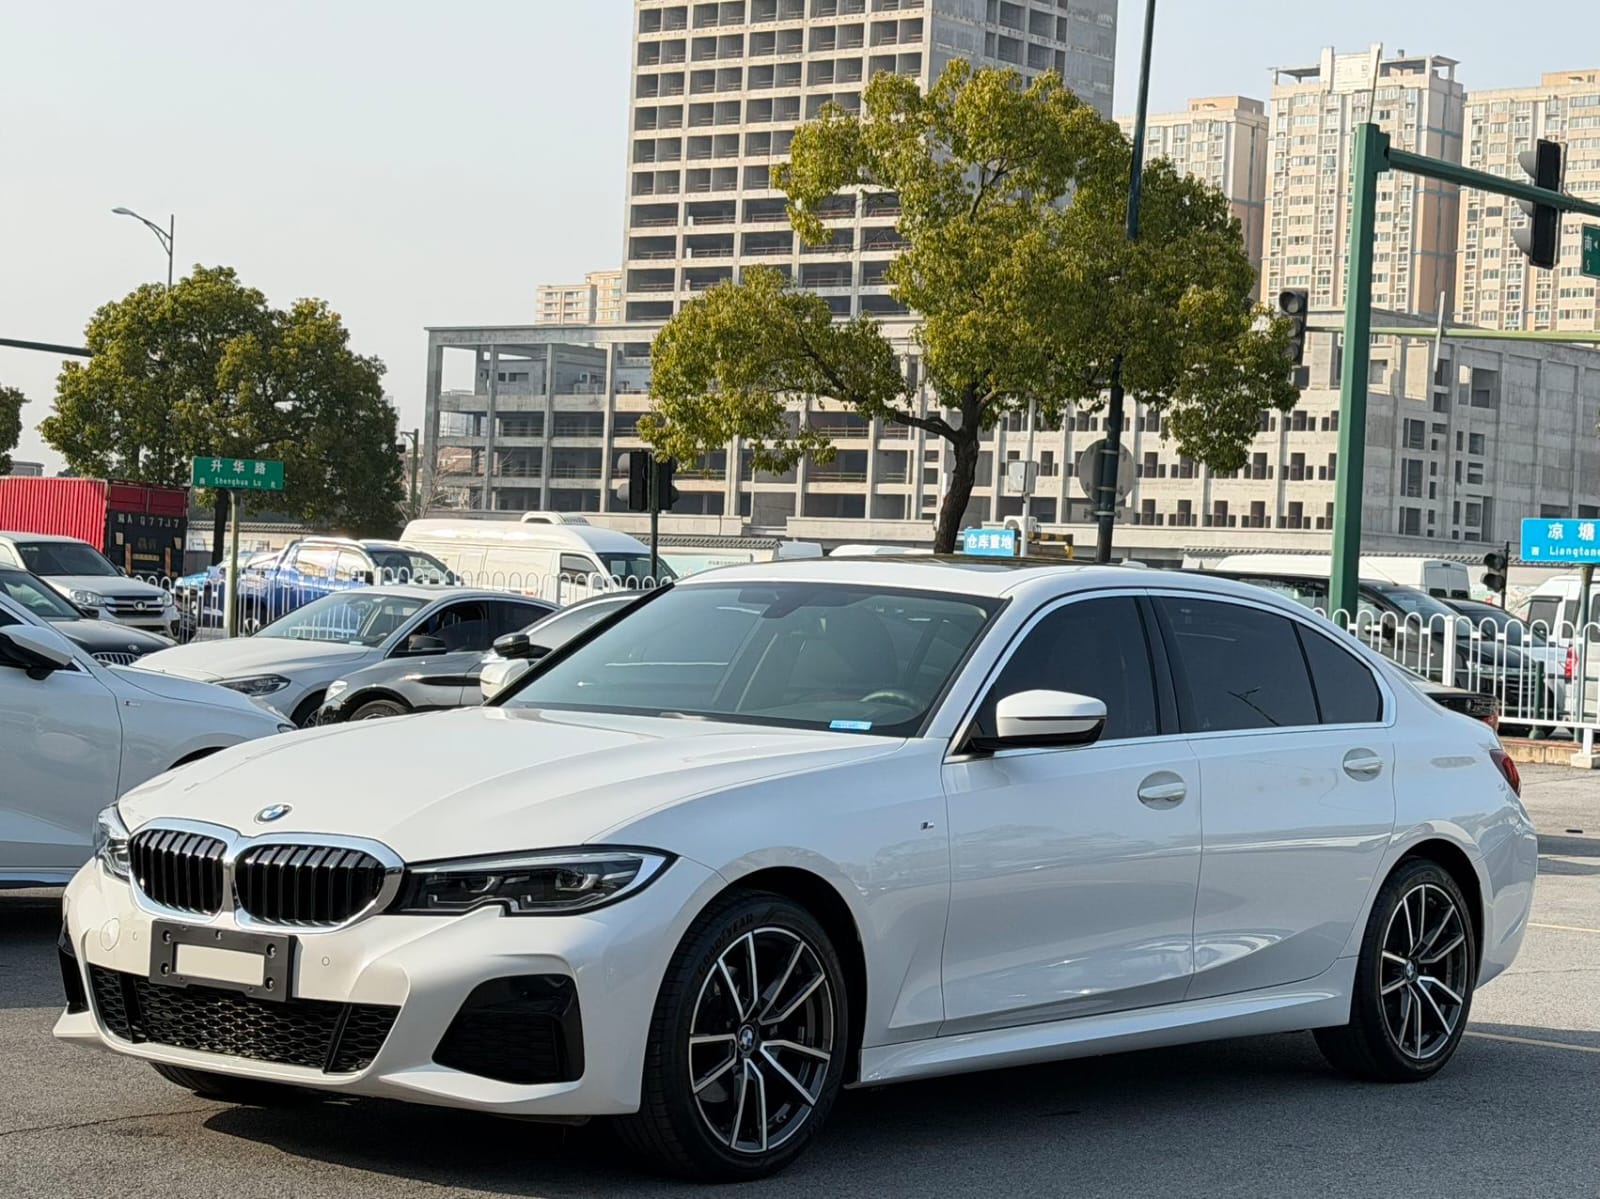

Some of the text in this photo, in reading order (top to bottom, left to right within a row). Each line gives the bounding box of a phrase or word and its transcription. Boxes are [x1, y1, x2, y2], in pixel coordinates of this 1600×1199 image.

[210, 459, 266, 475] 升华路
[215, 477, 249, 487] Shenghua
[966, 533, 1012, 550] 仓库重地
